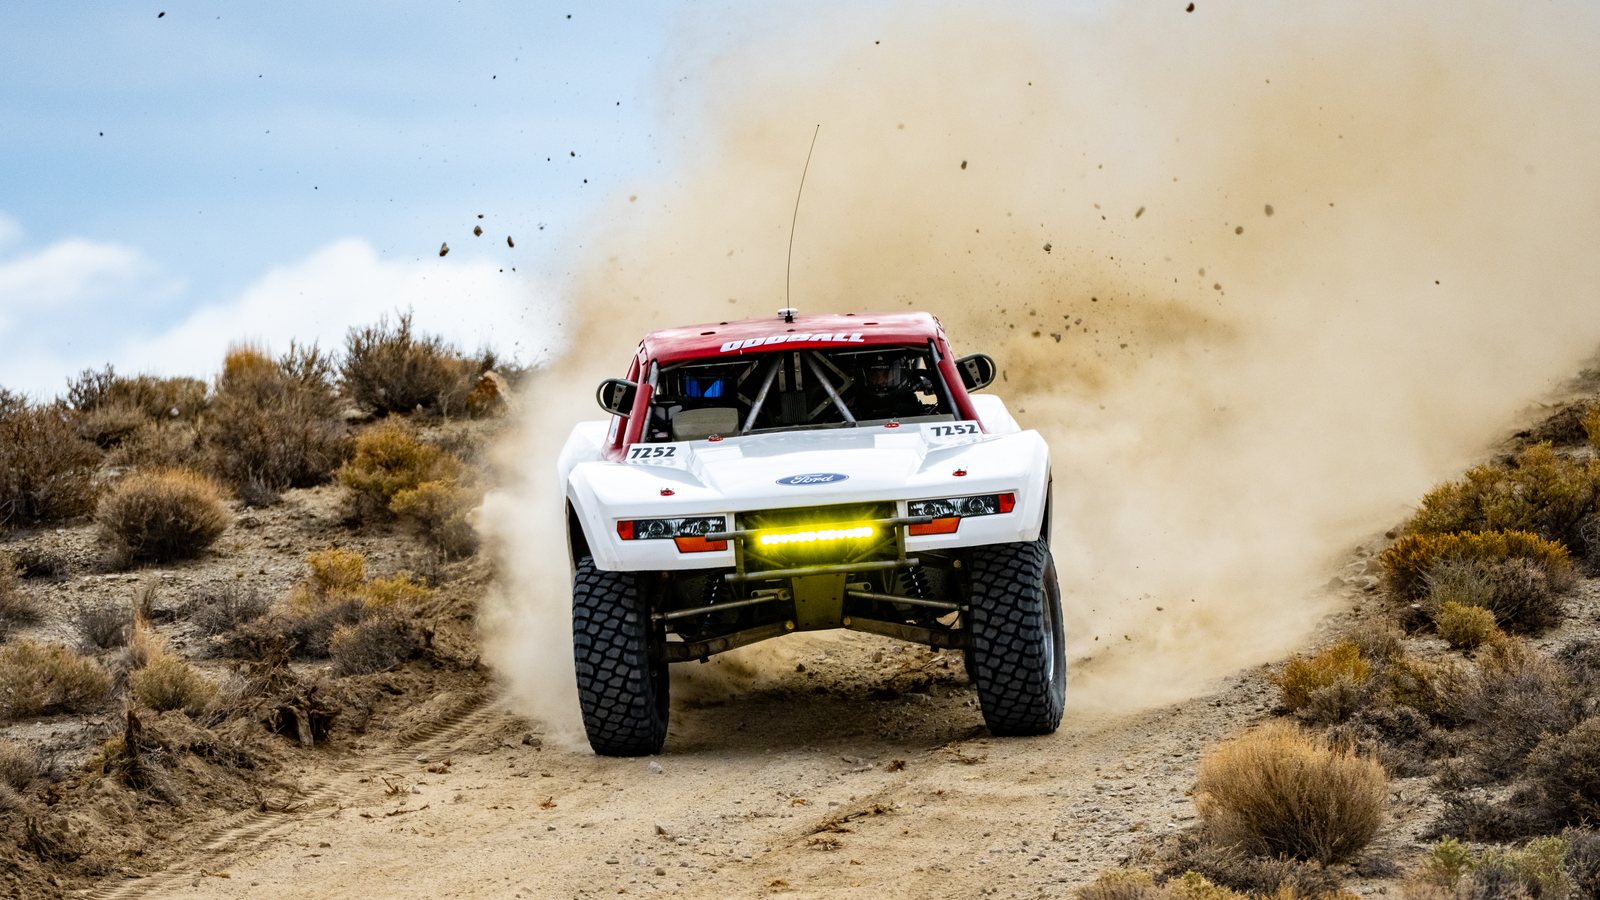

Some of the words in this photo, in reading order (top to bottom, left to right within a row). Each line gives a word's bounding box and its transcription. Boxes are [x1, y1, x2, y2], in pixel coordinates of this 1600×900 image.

[719, 332, 865, 353] ODDBALL
[930, 424, 979, 437] 7252
[630, 446, 677, 459] 7252
[790, 473, 835, 484] Ford
